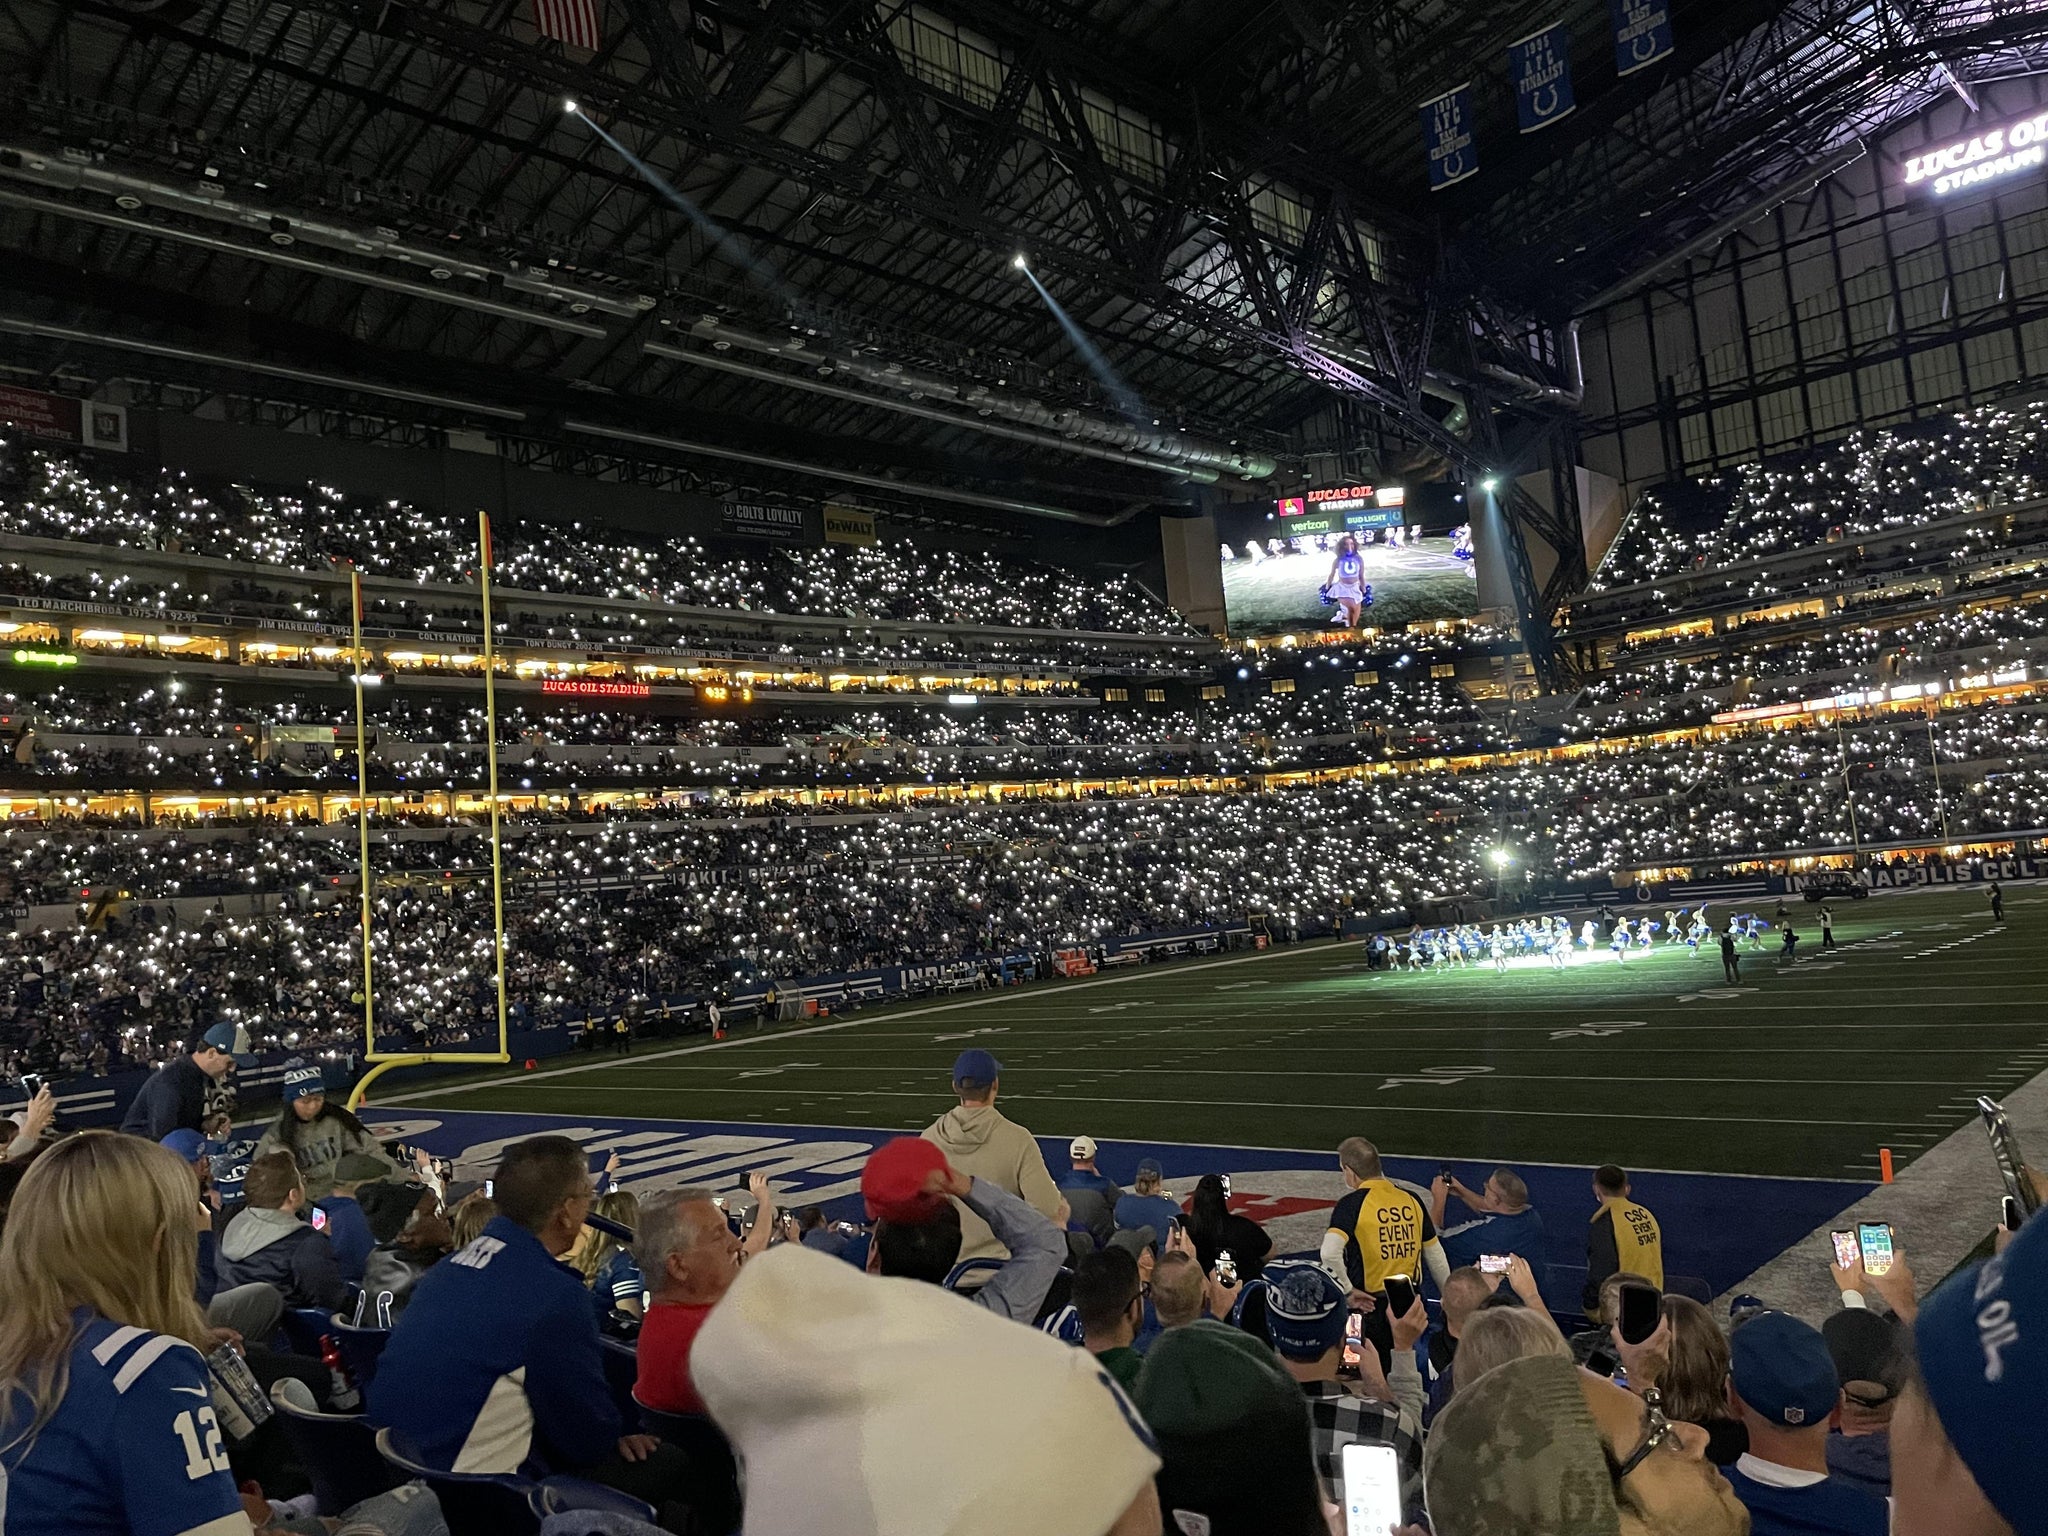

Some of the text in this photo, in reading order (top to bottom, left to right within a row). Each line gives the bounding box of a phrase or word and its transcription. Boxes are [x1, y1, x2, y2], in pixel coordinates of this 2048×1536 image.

[1904, 129, 2004, 184] LUCAS
[1934, 145, 2042, 194] STADIUM
[1307, 487, 1349, 502] LUCAS
[1350, 485, 1375, 498] OIL
[1318, 499, 1365, 511] STADIUM
[736, 504, 765, 521] COLTS
[766, 506, 803, 525] LOYALTY
[1347, 513, 1387, 525] BUD LIGHT
[1291, 518, 1329, 532] verizon
[18, 598, 39, 609] TED
[42, 600, 123, 616] MARCHIBRODA
[258, 620, 276, 630] JIM
[277, 621, 327, 634] HARBAUGH
[418, 631, 477, 644] COLTS NATION
[525, 640, 545, 648] TONY
[644, 646, 672, 655] MARVIN
[673, 649, 706, 658] HARRISON
[543, 681, 650, 695] LUCAS OIL STADIUM
[1376, 1205, 1414, 1224] CSC
[1623, 1207, 1648, 1223] CSC
[1378, 1223, 1415, 1243] EVENT
[1632, 1220, 1654, 1235] EVENT
[1637, 1232, 1657, 1246] STAFF
[1380, 1241, 1416, 1260] STAFF
[173, 1405, 231, 1480] 12
